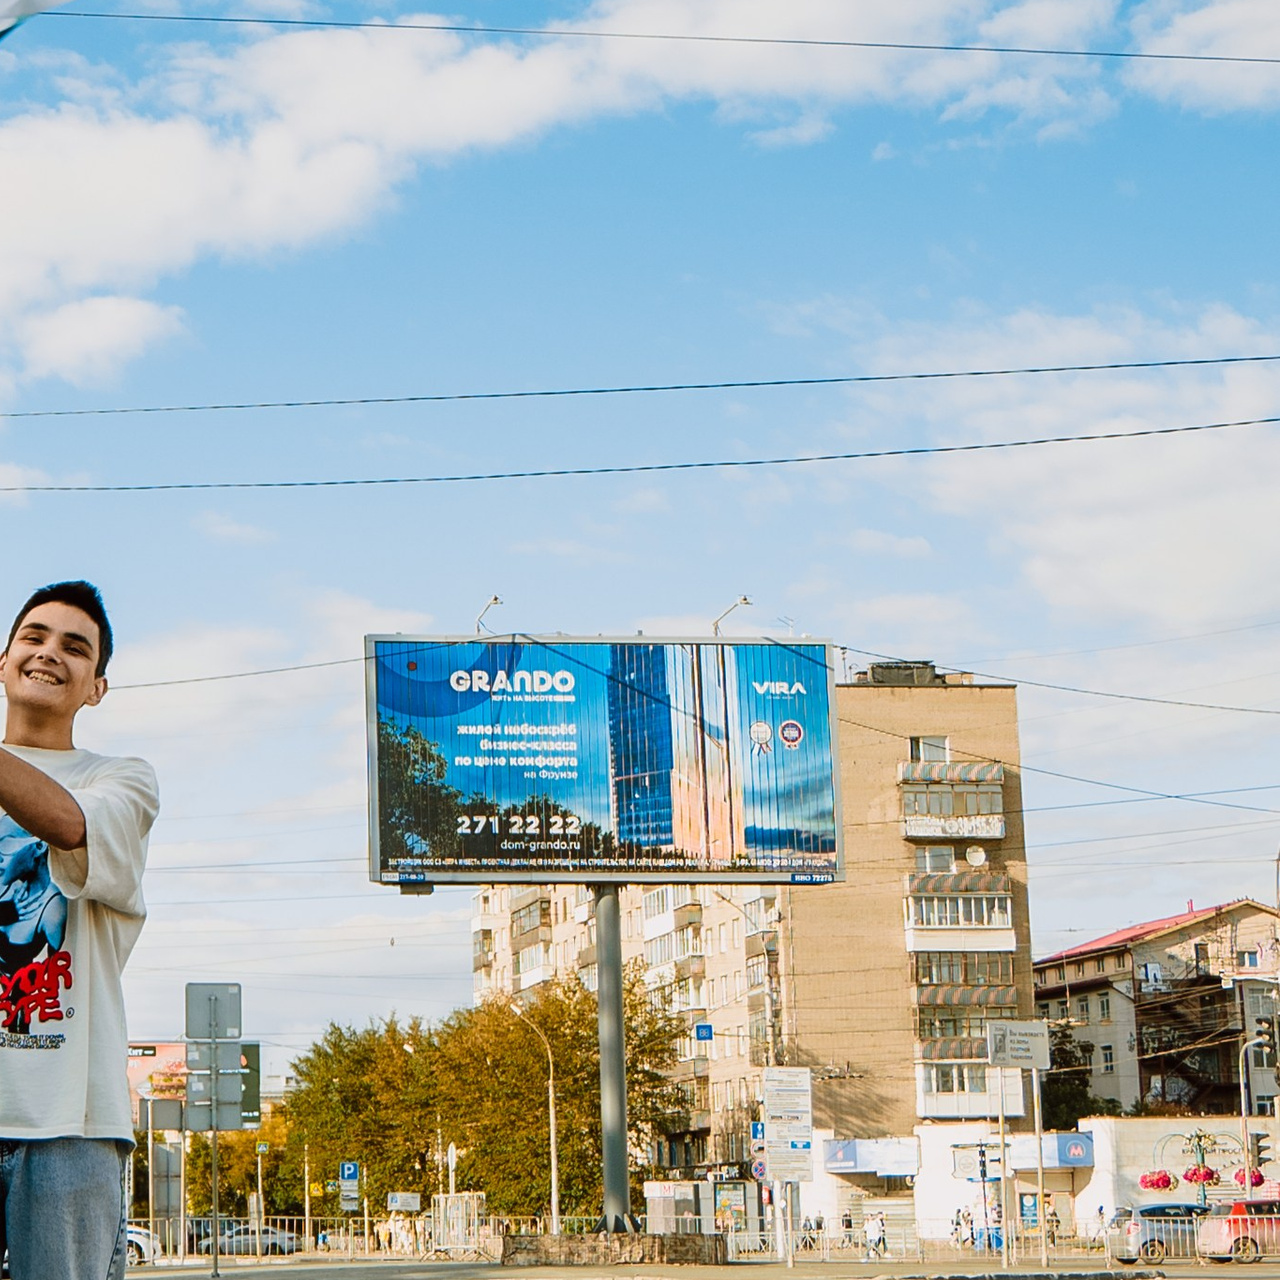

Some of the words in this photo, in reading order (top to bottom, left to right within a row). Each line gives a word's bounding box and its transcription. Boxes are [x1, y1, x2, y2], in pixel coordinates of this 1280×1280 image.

[449, 670, 575, 692] GRANDO
[752, 681, 807, 694] VIRA
[457, 723, 502, 735] жилой
[479, 739, 578, 751] бизнес-класса
[454, 756, 472, 766] по
[474, 756, 507, 767] цене
[509, 755, 578, 768] комфорта
[538, 769, 578, 780] Фрунзе
[456, 815, 500, 835] 271
[508, 815, 540, 835] 22
[549, 815, 581, 835] 22
[500, 839, 581, 851] dom-grando.ru
[0, 950, 73, 1002] YOUR
[344, 1164, 355, 1179] P
